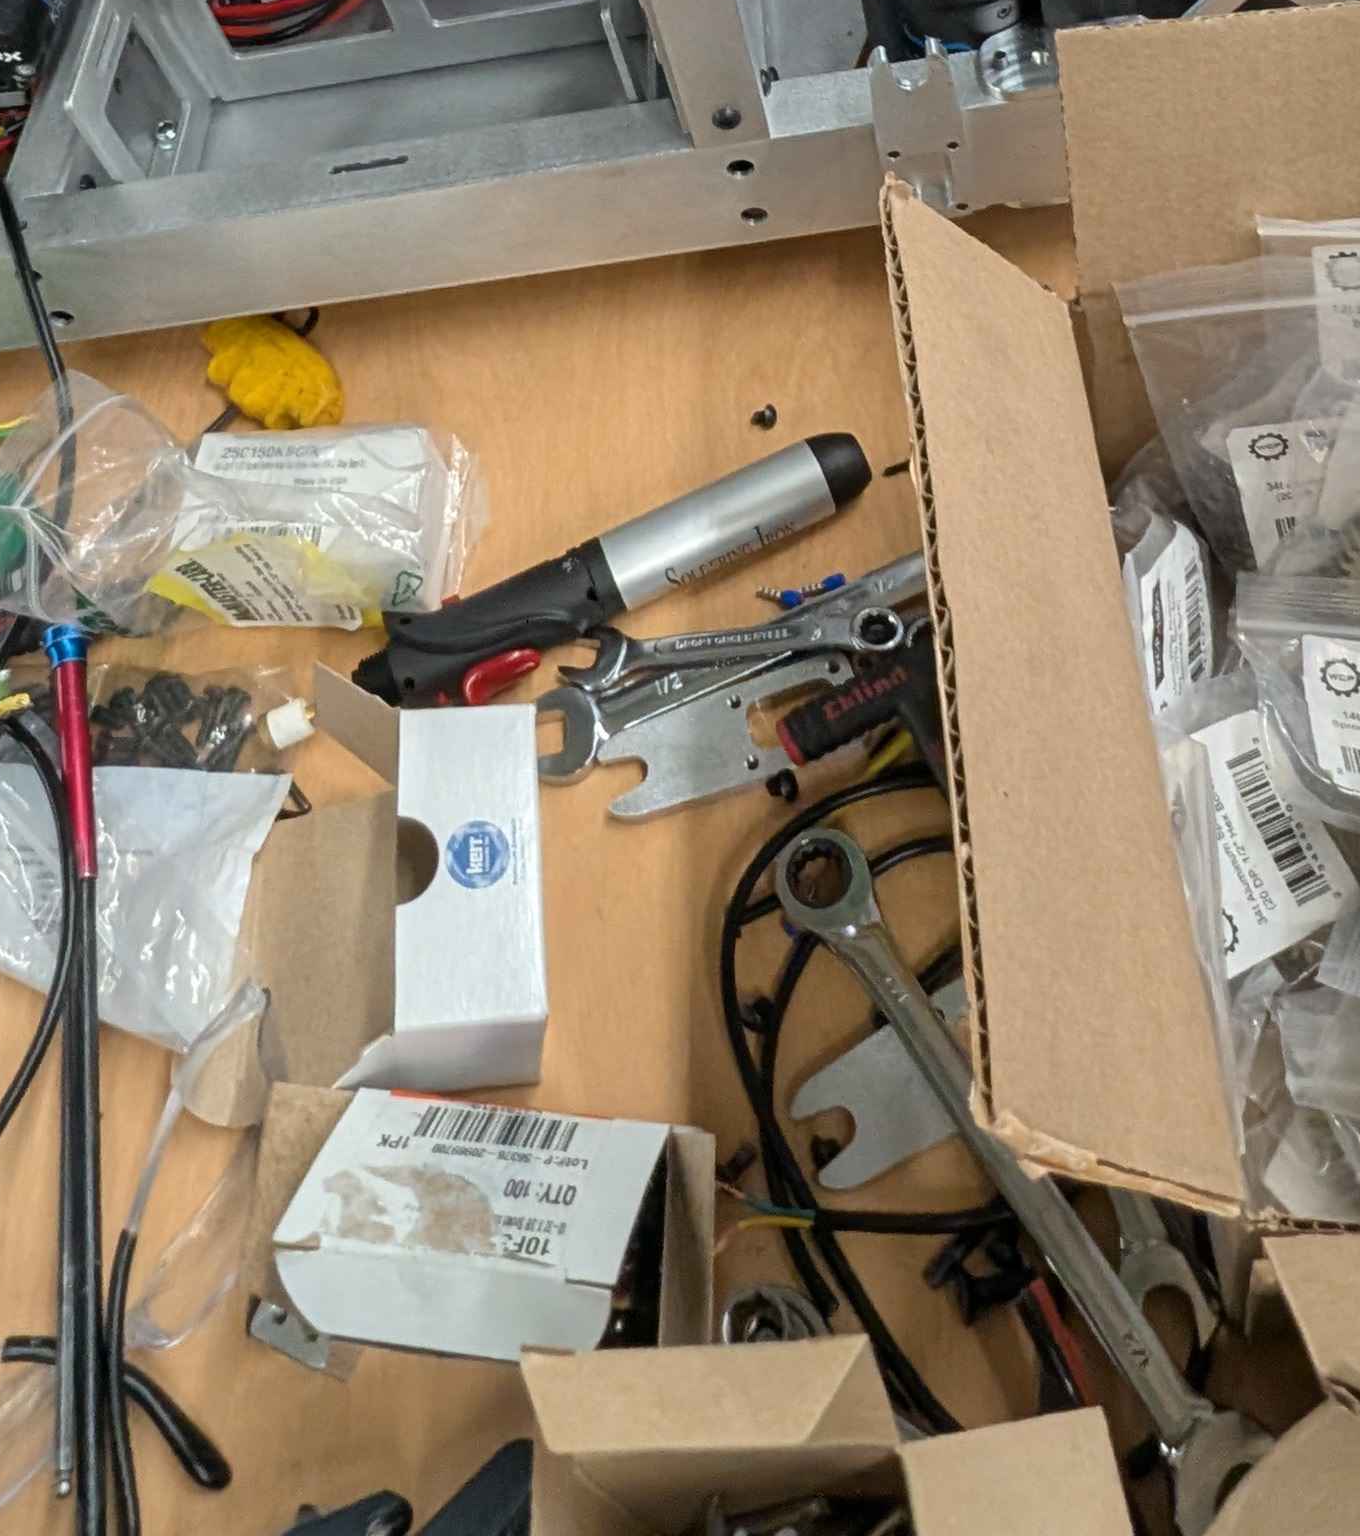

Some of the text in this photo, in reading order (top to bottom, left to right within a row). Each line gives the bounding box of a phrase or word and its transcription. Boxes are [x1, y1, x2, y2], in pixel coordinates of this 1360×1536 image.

[376, 1133, 410, 1150] 1PK
[502, 1177, 578, 1207] QTY: 100
